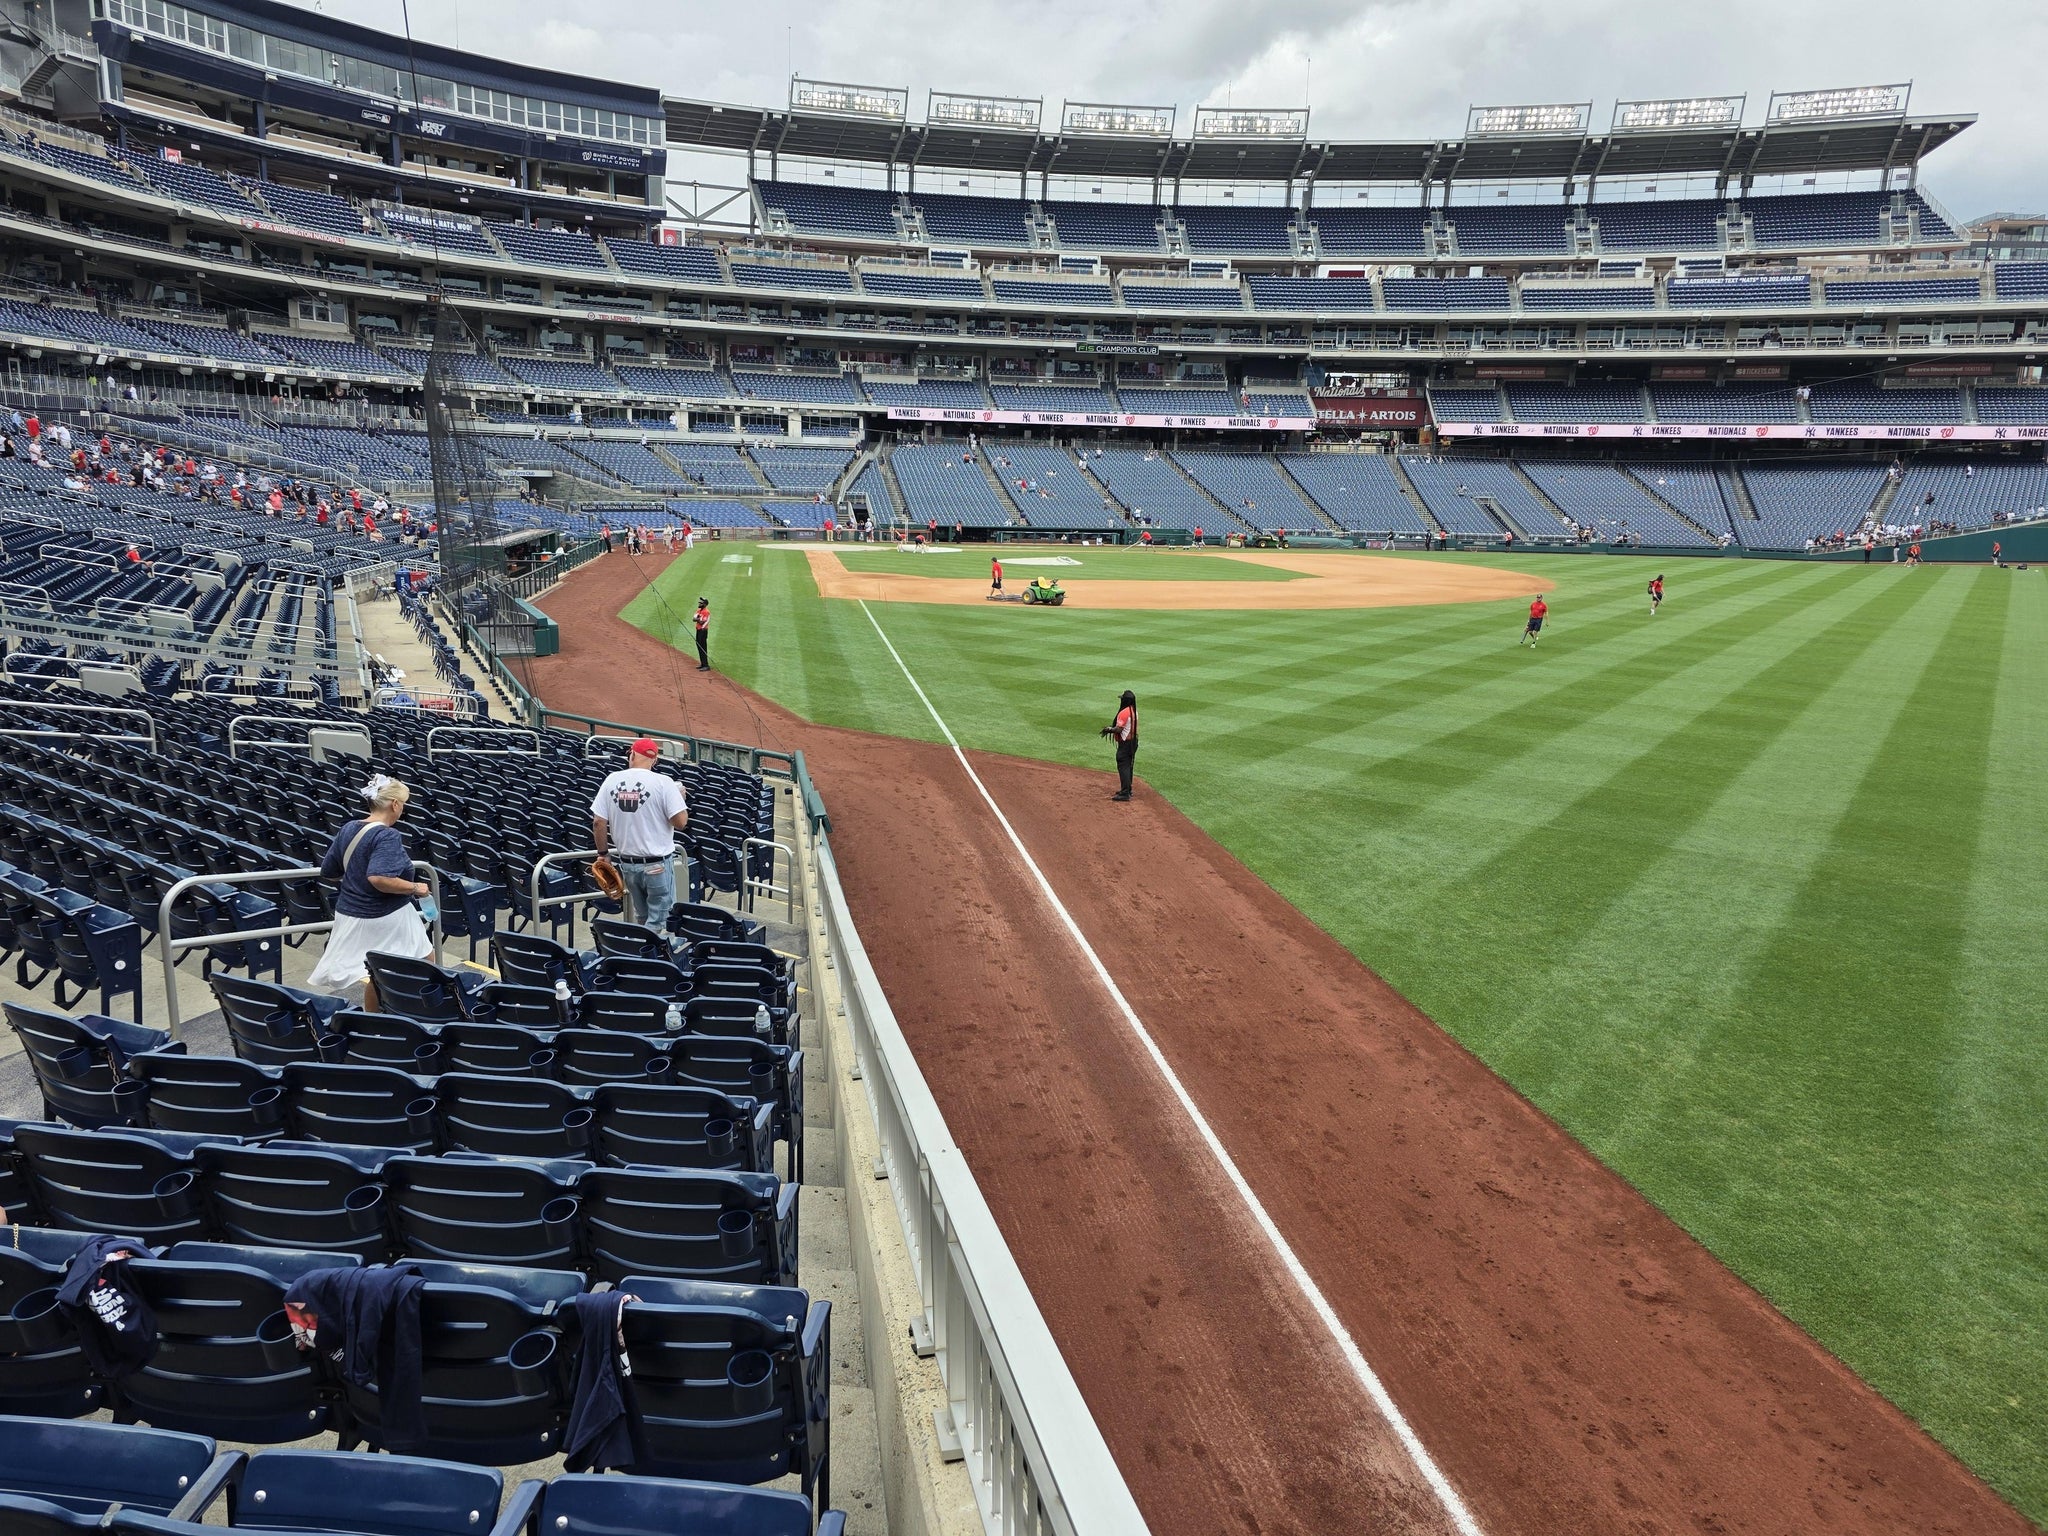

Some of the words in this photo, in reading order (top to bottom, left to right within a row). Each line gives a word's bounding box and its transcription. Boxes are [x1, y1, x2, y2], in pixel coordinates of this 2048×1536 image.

[593, 152, 618, 160] SHIRLEY
[618, 156, 640, 164] POVICH
[273, 225, 313, 239] WASHINGTON
[313, 232, 345, 244] NATIONALS
[1096, 345, 1137, 353] CHAMPIONS
[1138, 346, 1157, 354] CLUB
[346, 386, 369, 398] PNC
[1314, 386, 1366, 398] Nationals
[894, 408, 921, 418] YANKEES
[943, 410, 976, 420] NATIONALS
[1038, 413, 1064, 423] YANKEES
[1085, 415, 1118, 424] NATIONALS
[1313, 410, 1355, 420] TELLA
[1369, 410, 1416, 421] ARTOIS
[1180, 417, 1207, 426] YANKEES
[1228, 418, 1261, 427] NATIONALS
[1490, 425, 1520, 434] YANKEES
[1543, 425, 1580, 435] NATIONALS
[1651, 426, 1682, 435] YANKEES
[1707, 426, 1747, 436] NATIONALS
[1825, 427, 1859, 436] YANKEES
[1887, 427, 1931, 437] NATIONALS
